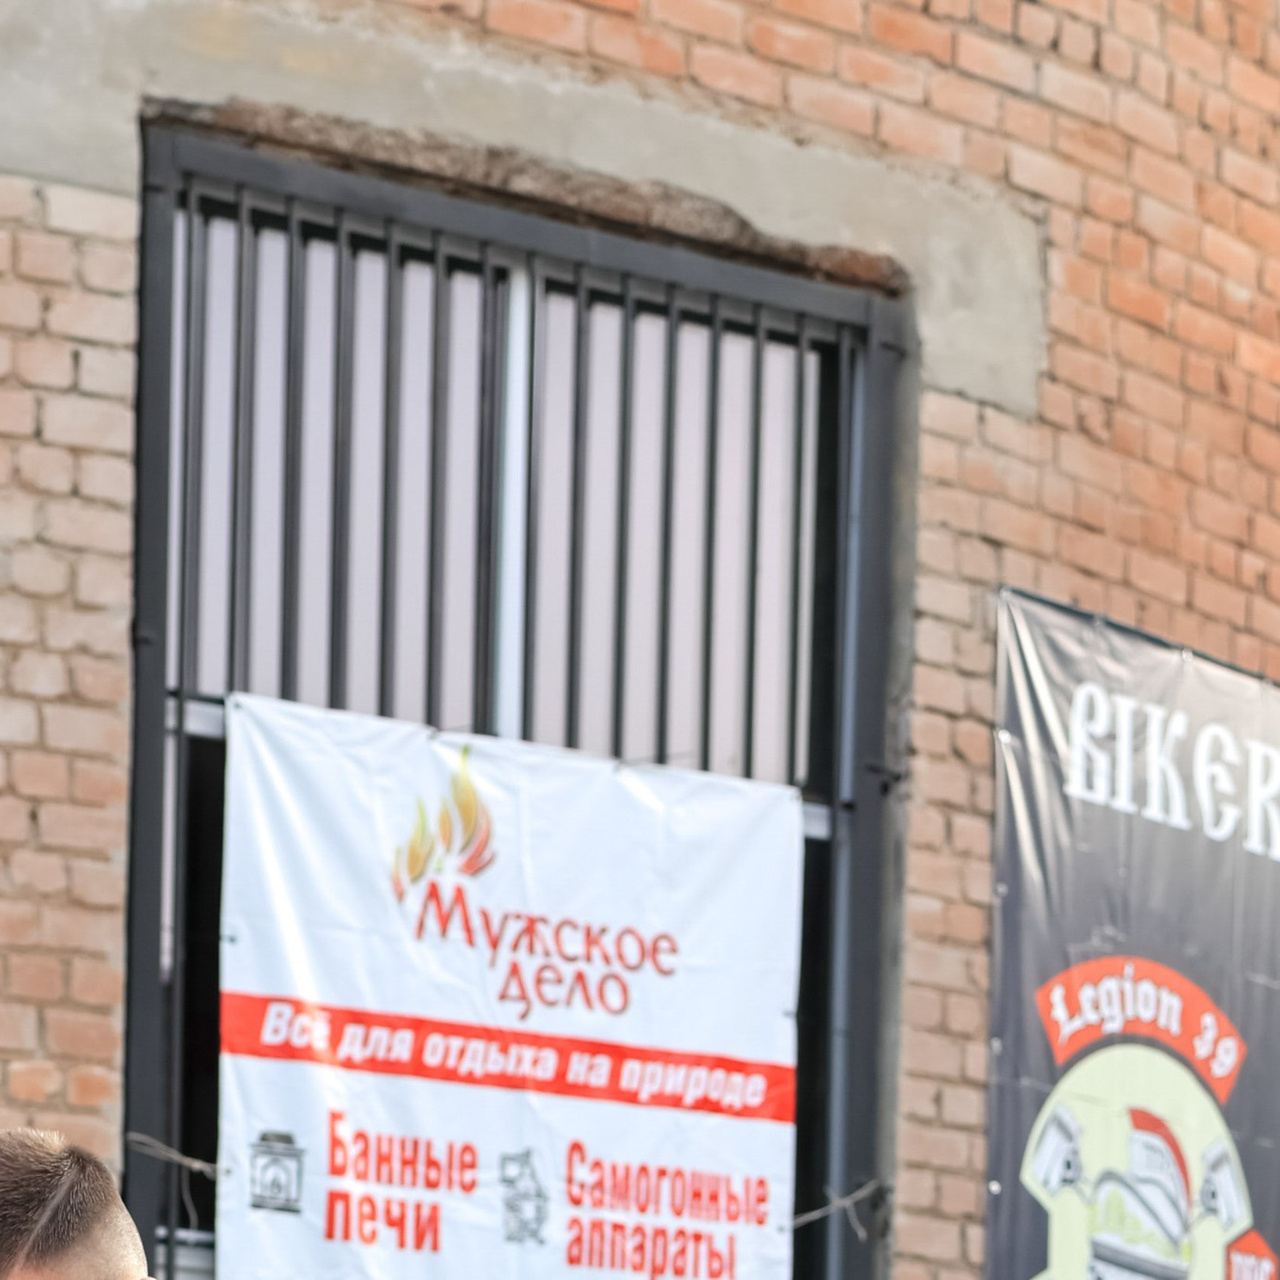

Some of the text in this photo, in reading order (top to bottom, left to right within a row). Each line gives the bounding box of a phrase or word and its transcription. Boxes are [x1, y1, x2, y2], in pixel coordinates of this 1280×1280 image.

[414, 879, 678, 977] Мужское
[1050, 961, 1239, 1078] Legion 39
[336, 1021, 414, 1064] для
[422, 1031, 557, 1080] отдыха
[566, 1050, 610, 1086] на
[619, 1058, 767, 1108] природе
[328, 1110, 477, 1193] Банные
[566, 1139, 768, 1227] Самогонные
[324, 1190, 440, 1254] печи
